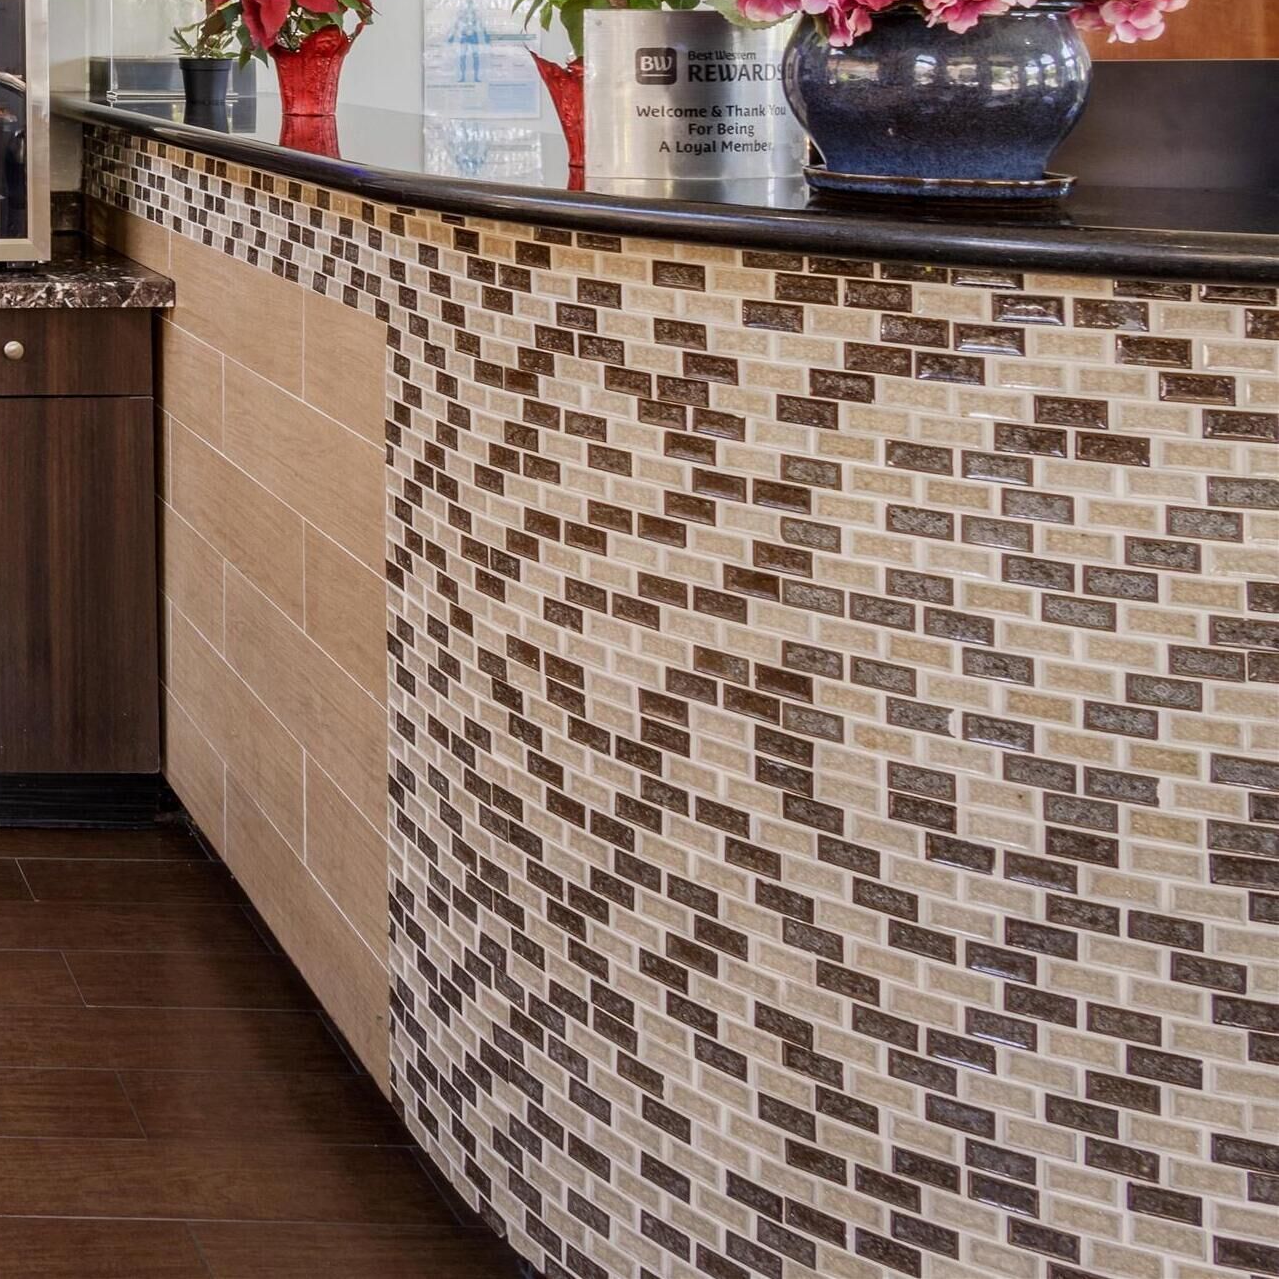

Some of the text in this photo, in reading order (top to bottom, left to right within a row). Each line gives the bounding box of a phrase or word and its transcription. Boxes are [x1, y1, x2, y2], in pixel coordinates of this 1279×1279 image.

[688, 50, 757, 61] Best Western
[640, 55, 673, 72] BW
[688, 63, 784, 83] REWARDS
[636, 105, 786, 118] Welcome & Thank You
[688, 123, 755, 138] For Being
[659, 142, 671, 153] A
[676, 141, 717, 156] Loyal
